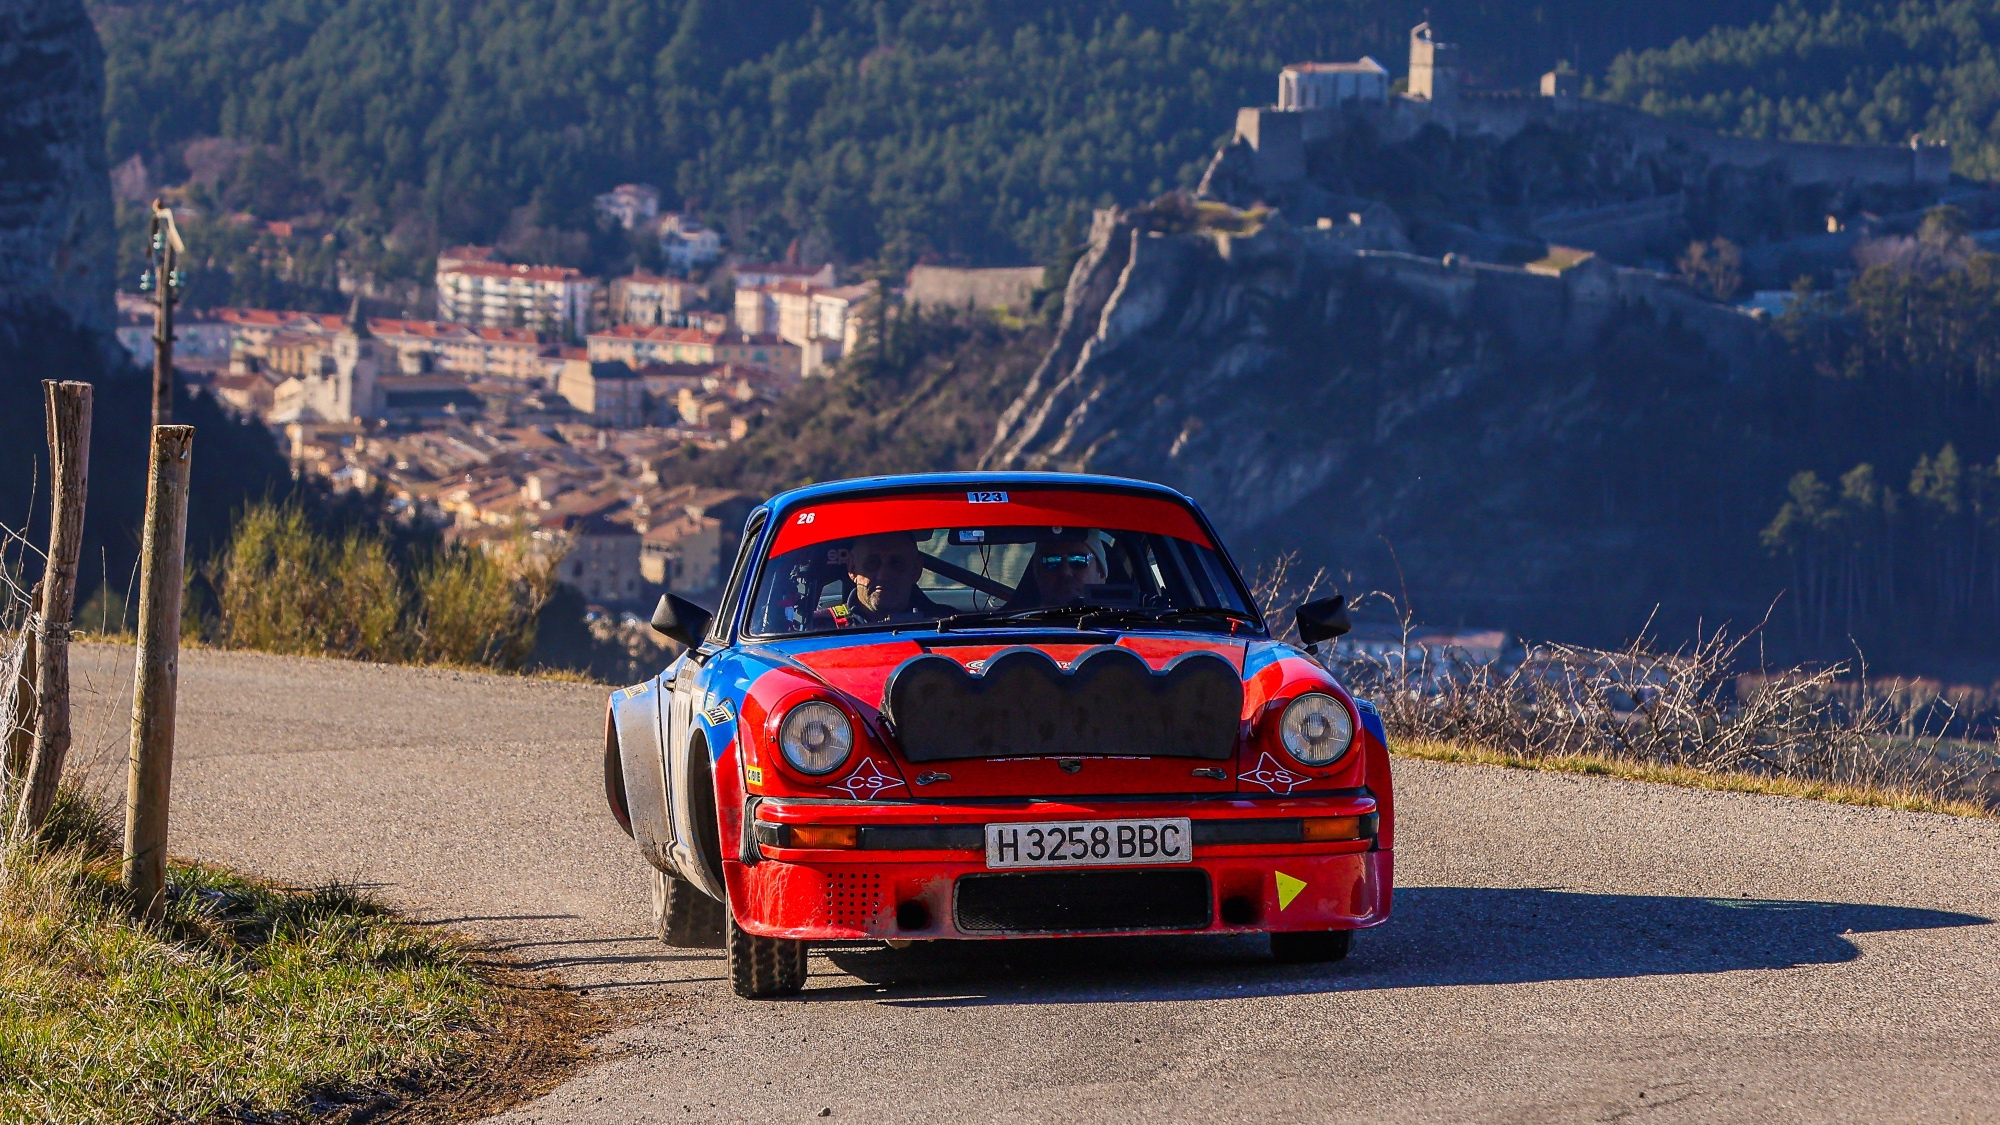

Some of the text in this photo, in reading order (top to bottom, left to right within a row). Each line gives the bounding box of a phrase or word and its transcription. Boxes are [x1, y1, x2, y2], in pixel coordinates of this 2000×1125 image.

[973, 492, 1003, 502] 123
[797, 512, 816, 525] 26
[846, 776, 883, 789] CS
[1255, 770, 1293, 784] CS
[998, 824, 1181, 862] H 3258 BBC
